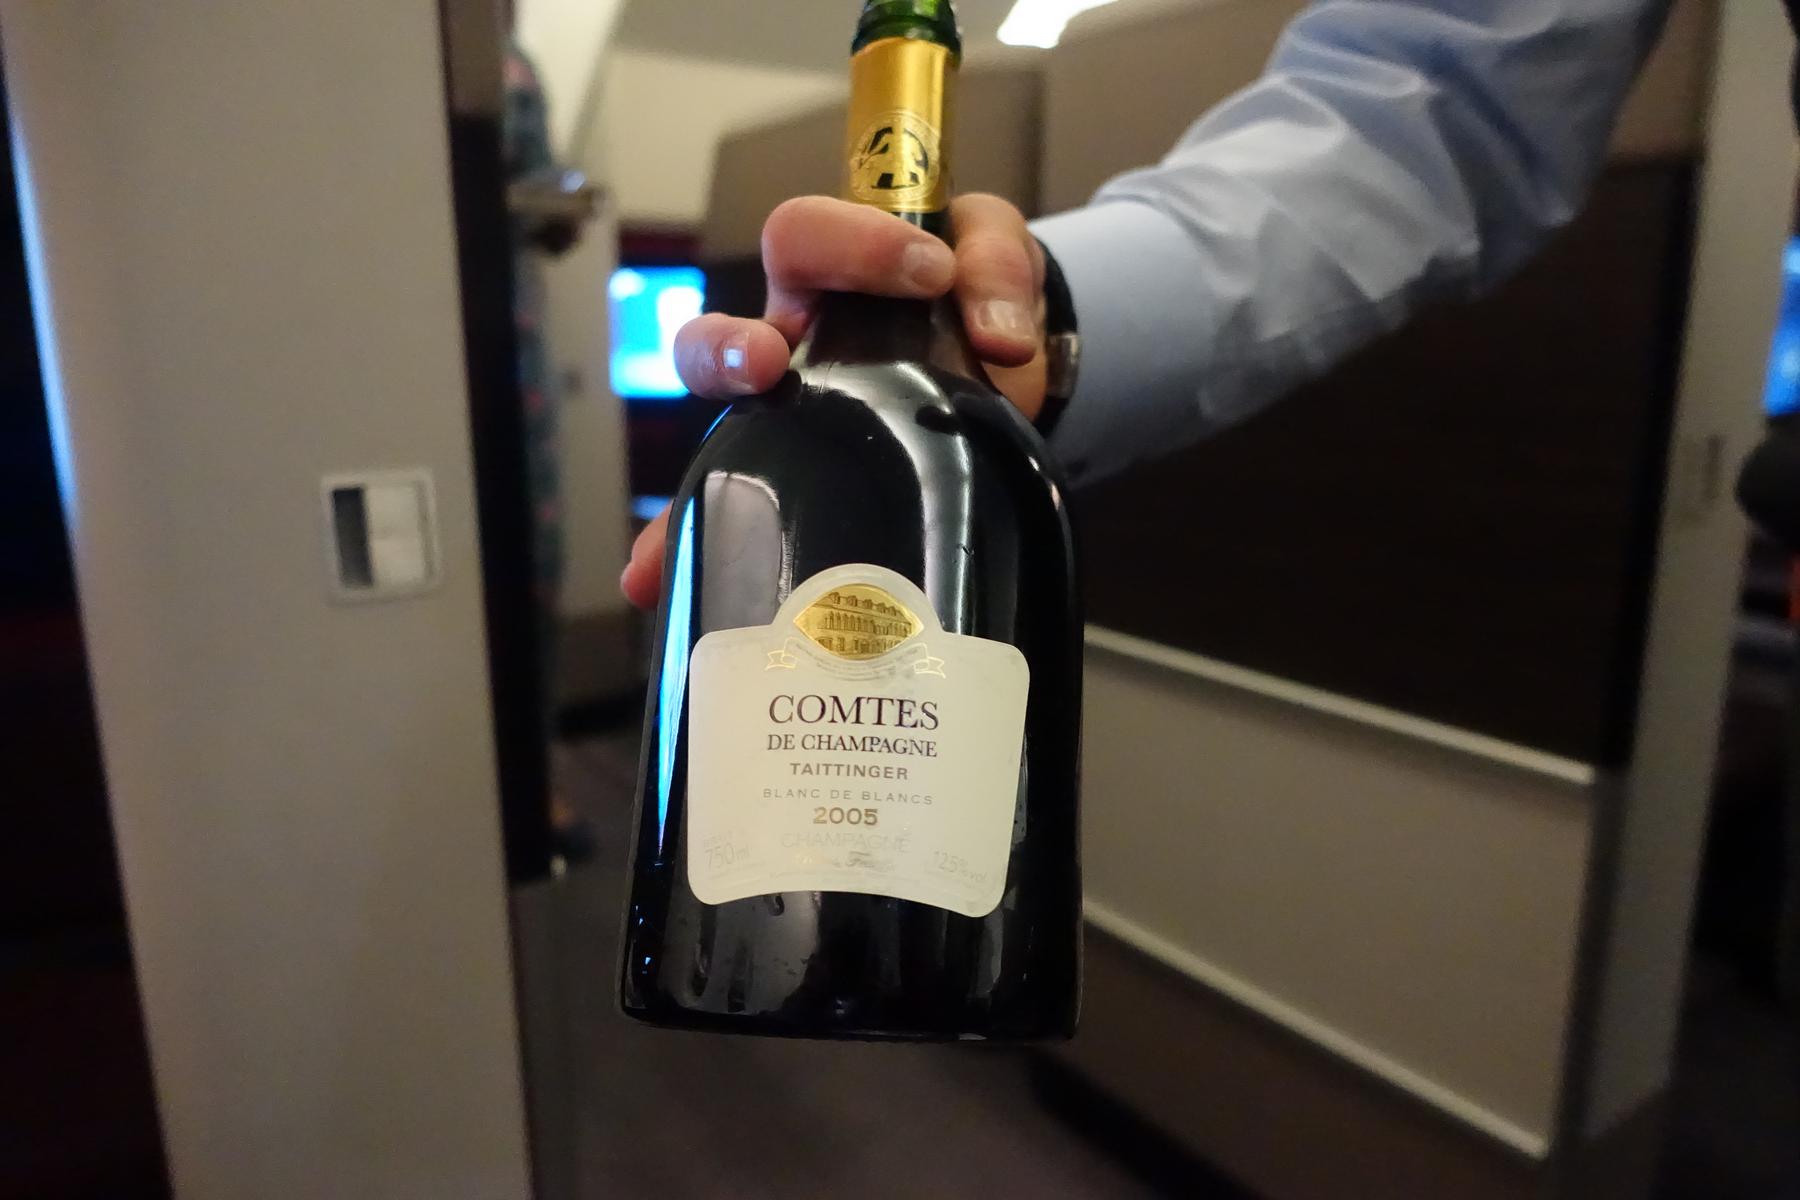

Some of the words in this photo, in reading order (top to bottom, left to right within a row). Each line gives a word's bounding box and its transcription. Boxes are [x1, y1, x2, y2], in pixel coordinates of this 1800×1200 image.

[769, 694, 939, 731] COMTES
[767, 733, 796, 751] DE
[800, 733, 938, 758] CHAMPAGNE
[789, 762, 908, 781] TAITTINGER
[763, 788, 821, 800] BLANC
[830, 789, 852, 800] DE
[861, 790, 934, 806] BLANCS
[813, 806, 879, 827] 2005
